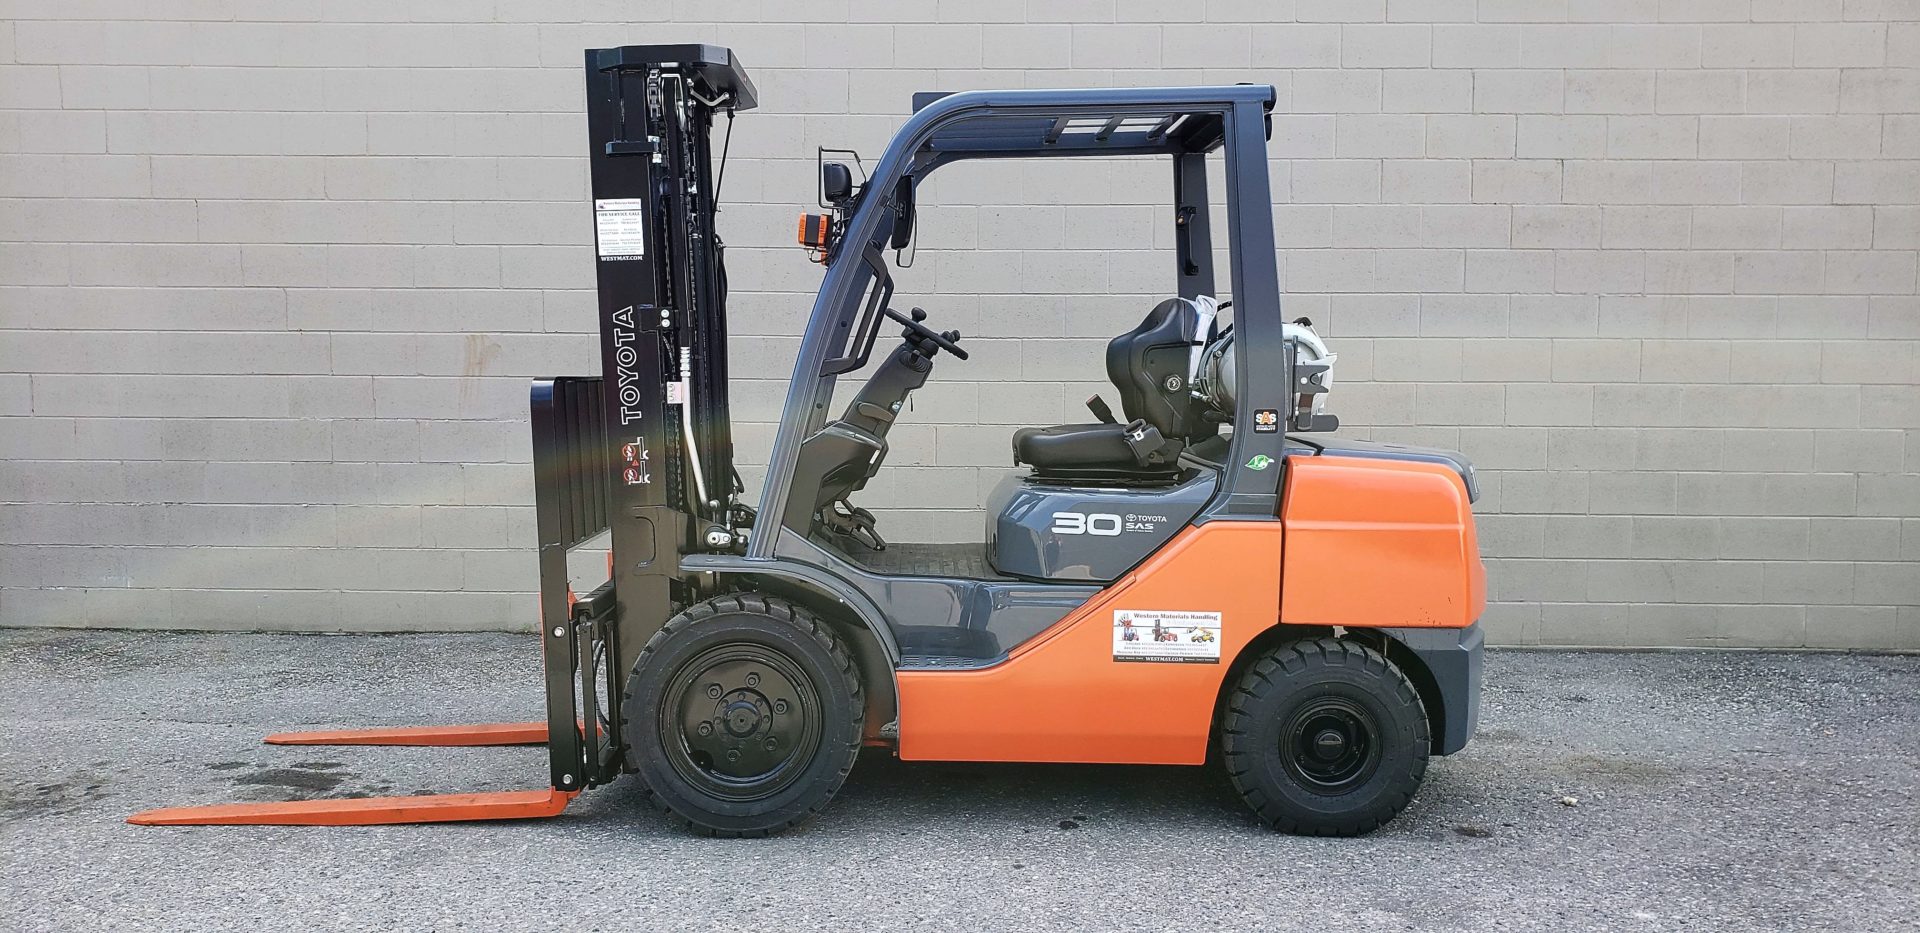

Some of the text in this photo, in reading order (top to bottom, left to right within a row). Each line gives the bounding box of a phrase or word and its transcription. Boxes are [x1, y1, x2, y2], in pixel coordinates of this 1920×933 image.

[613, 306, 642, 425] TOYOTA
[1255, 411, 1277, 424] SAS
[1051, 512, 1122, 536] 30
